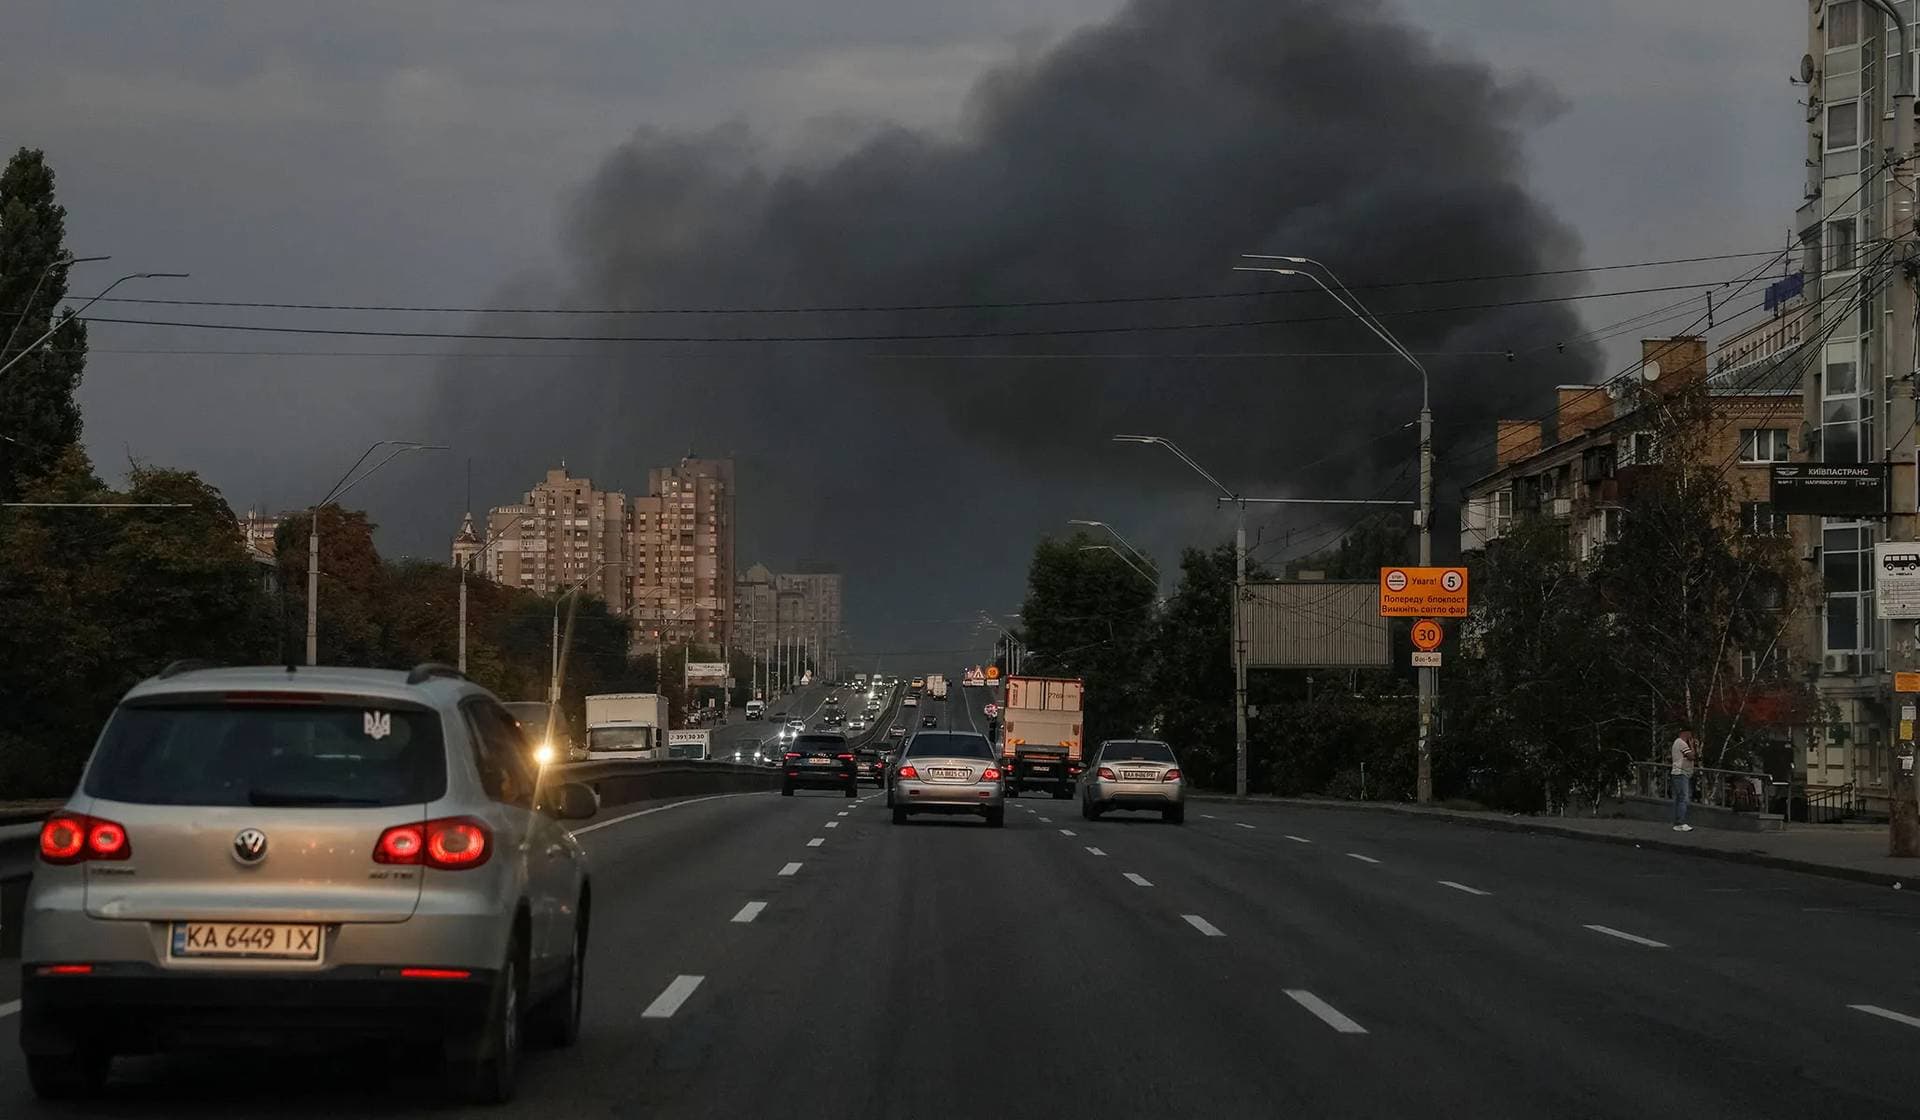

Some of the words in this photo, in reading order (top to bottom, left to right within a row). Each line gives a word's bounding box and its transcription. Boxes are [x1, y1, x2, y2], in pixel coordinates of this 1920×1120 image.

[1808, 468, 1869, 476] КИЇВПАСТРАНС
[1411, 577, 1437, 585] Увага!
[1447, 576, 1456, 588] 5
[1384, 595, 1424, 604] Попереду
[1427, 595, 1465, 604] блокпост
[1382, 605, 1419, 613] Вимкніть
[1421, 605, 1447, 613] світло
[1448, 606, 1466, 614] фар
[1419, 629, 1435, 641] 30
[187, 926, 218, 947] KA
[225, 927, 275, 948] 6449
[286, 929, 314, 950] IX
